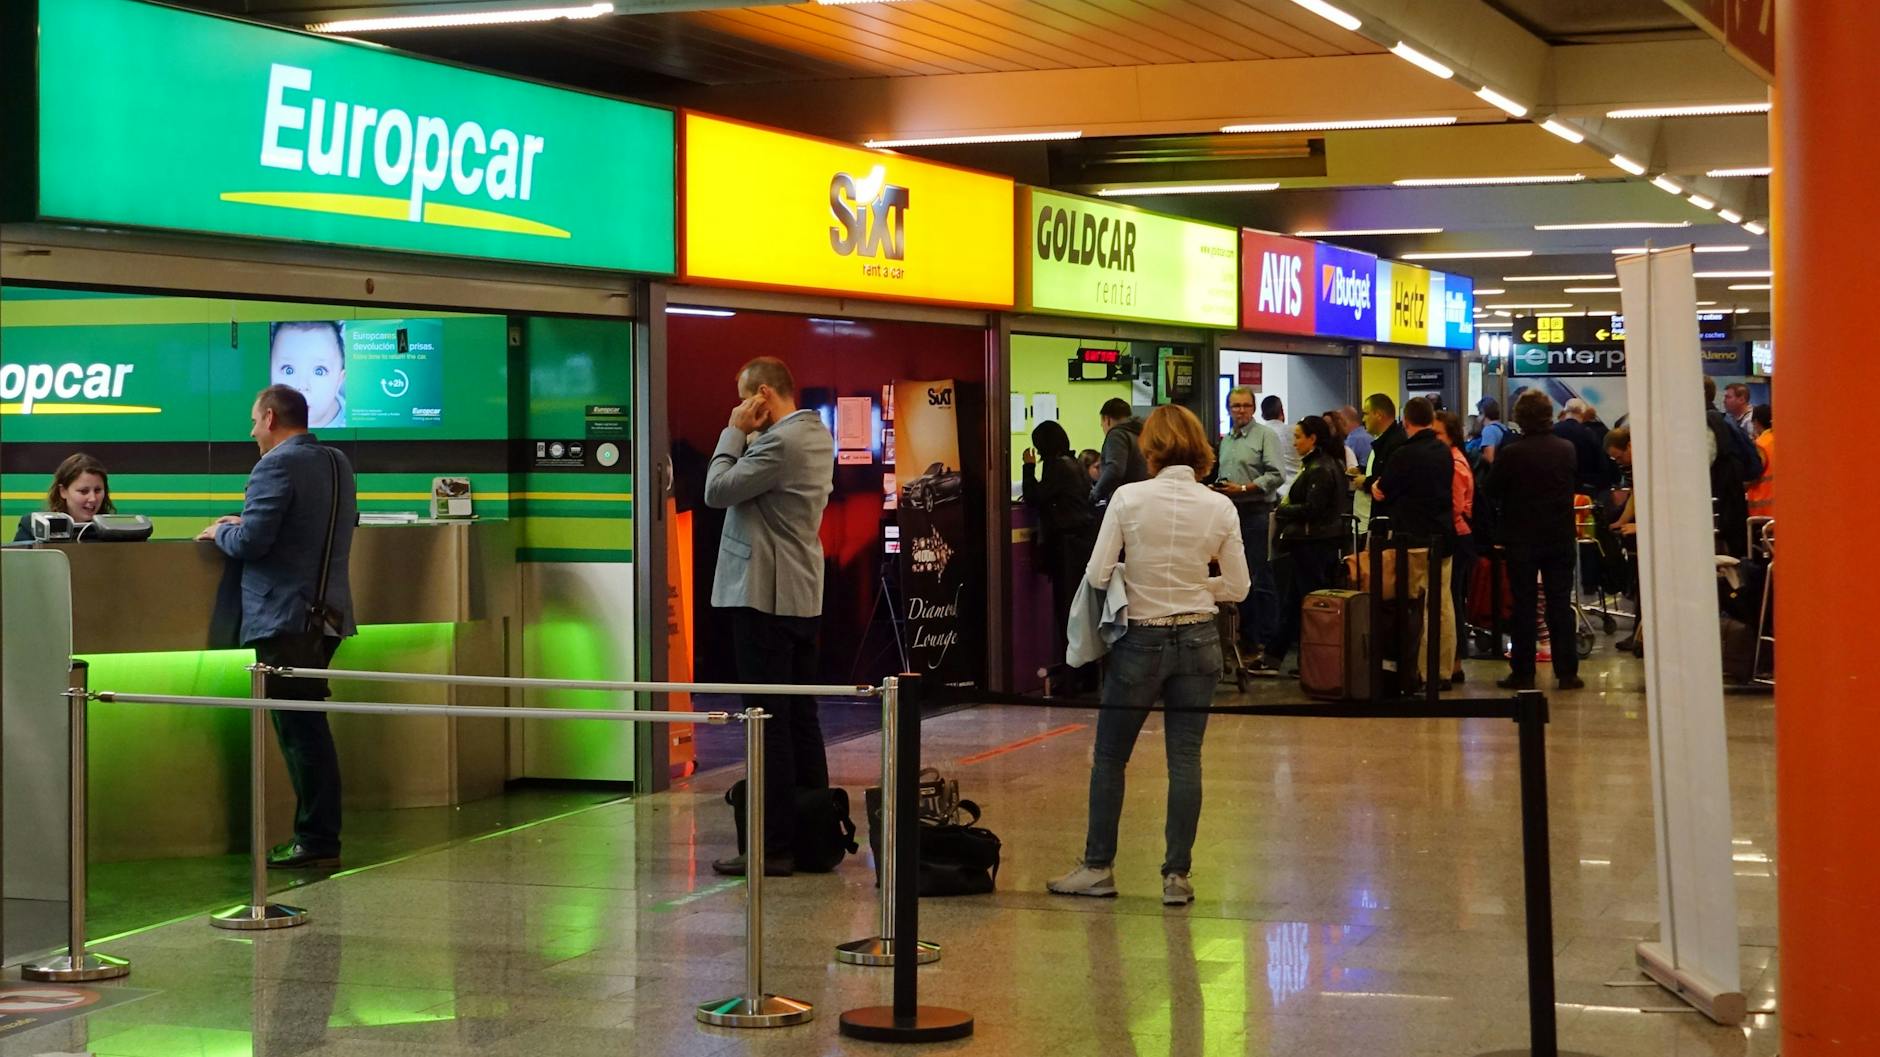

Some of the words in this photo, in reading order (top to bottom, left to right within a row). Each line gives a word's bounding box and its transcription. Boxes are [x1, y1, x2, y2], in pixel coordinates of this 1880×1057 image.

[260, 63, 545, 223] Europcar
[1037, 205, 1136, 272] GOLDCAR
[863, 264, 881, 276] rent
[883, 268, 889, 278] a
[891, 269, 904, 279] car
[1096, 281, 1137, 306] rental
[1258, 252, 1302, 317] AVIS
[1336, 267, 1371, 321] Budget
[1394, 280, 1425, 329] Hertz
[1523, 347, 1625, 369] enterp
[0, 363, 134, 414] opcar
[412, 407, 441, 415] Europcar
[912, 625, 958, 669] Lounge
